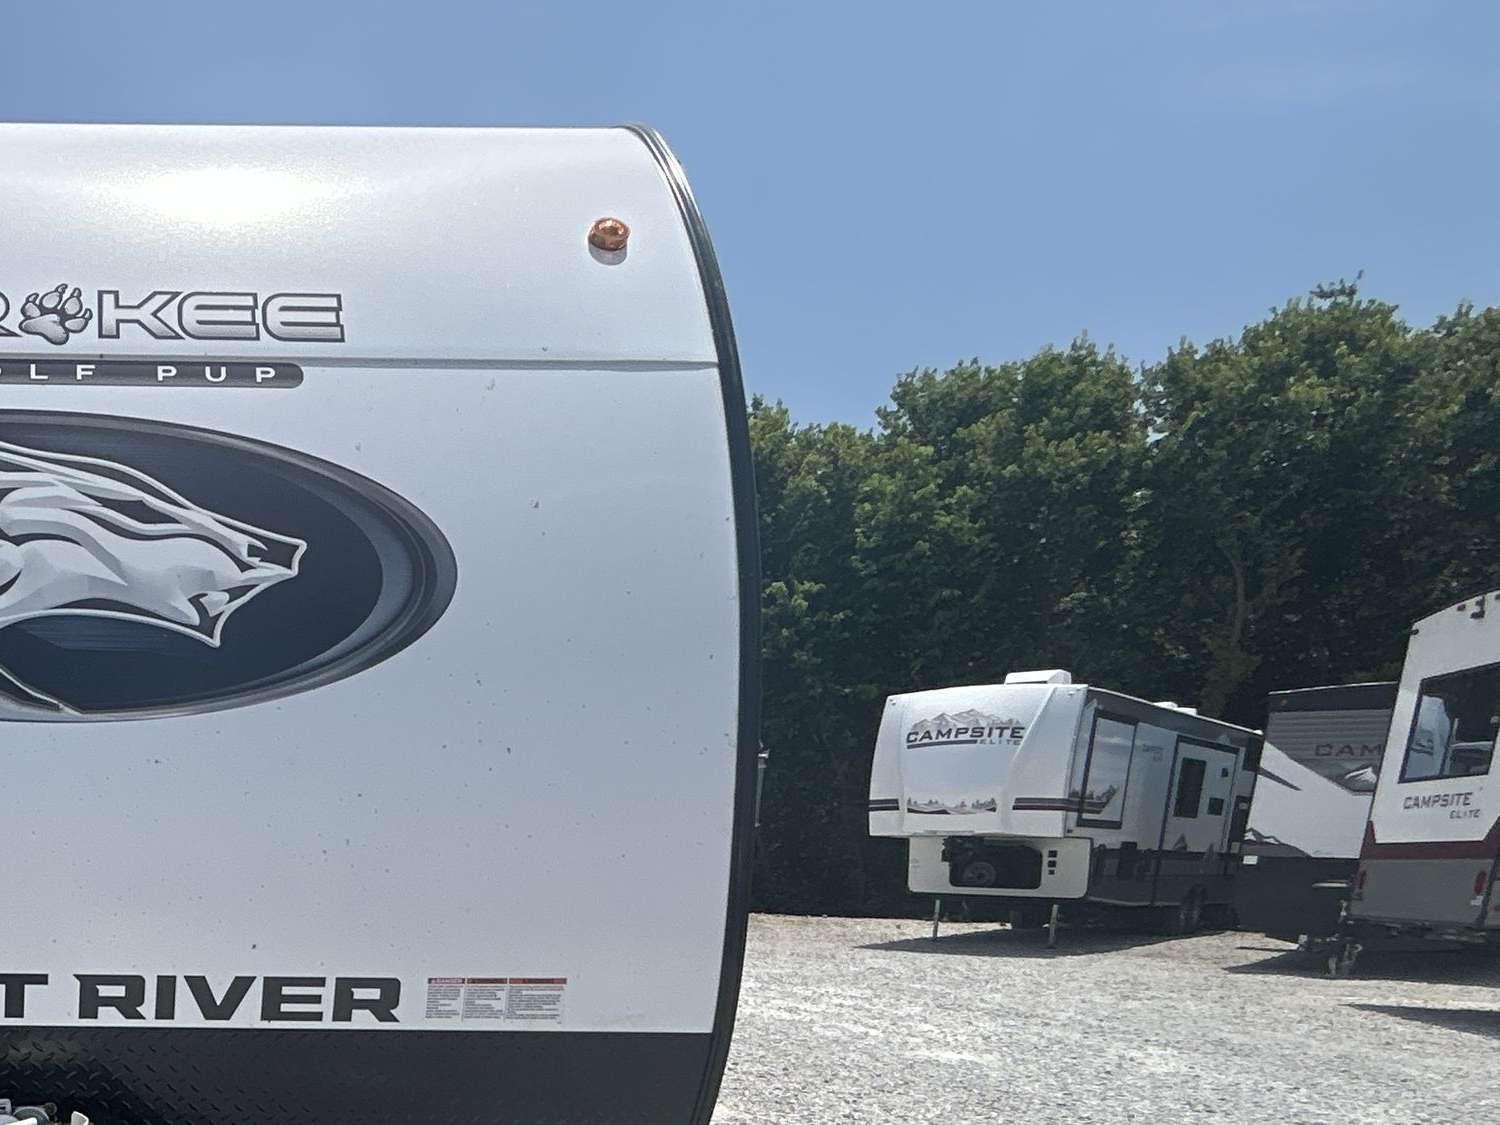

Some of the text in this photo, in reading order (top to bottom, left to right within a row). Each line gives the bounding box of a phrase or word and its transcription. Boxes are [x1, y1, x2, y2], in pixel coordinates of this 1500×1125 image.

[156, 364, 277, 384] PUP
[906, 726, 1026, 744] CAMPSITE
[1403, 791, 1474, 810] CAMPSITE
[1449, 808, 1481, 819] ELITE
[72, 973, 402, 1023] RIVER
